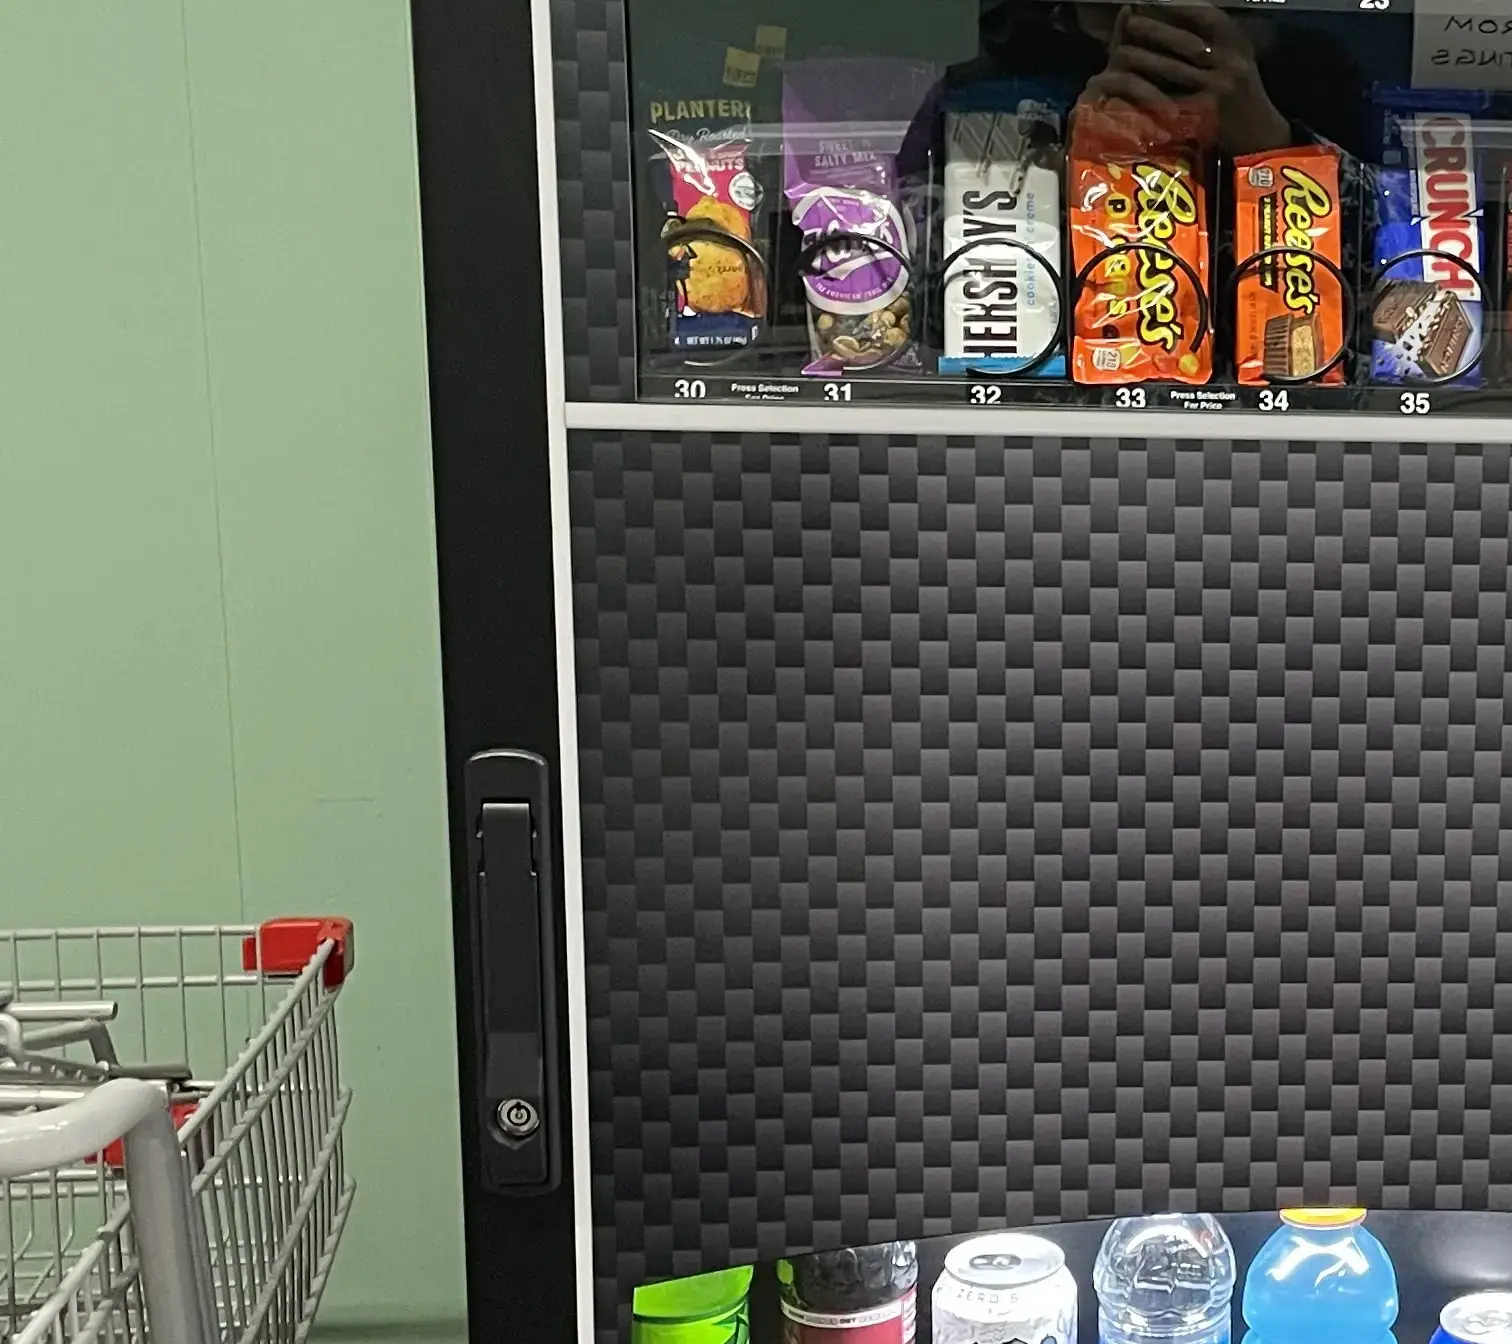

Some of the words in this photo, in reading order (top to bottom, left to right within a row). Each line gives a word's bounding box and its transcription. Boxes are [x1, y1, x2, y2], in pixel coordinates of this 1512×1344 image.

[650, 100, 751, 124] PLANTER
[814, 153, 850, 168] SALTY
[851, 151, 877, 164] MIX
[1422, 116, 1476, 291] CRUNCH
[1281, 166, 1321, 316] Reese's
[962, 189, 1019, 360] HERSHY'S
[674, 380, 706, 399] 30
[823, 382, 852, 402] 31
[970, 385, 1002, 405] 32
[1115, 388, 1147, 409] 33
[1170, 391, 1195, 401] Press
[1196, 391, 1236, 402] Selection
[1183, 401, 1198, 410] For
[1200, 401, 1223, 411] Price
[1258, 390, 1290, 412] 34
[1400, 393, 1431, 415] 35
